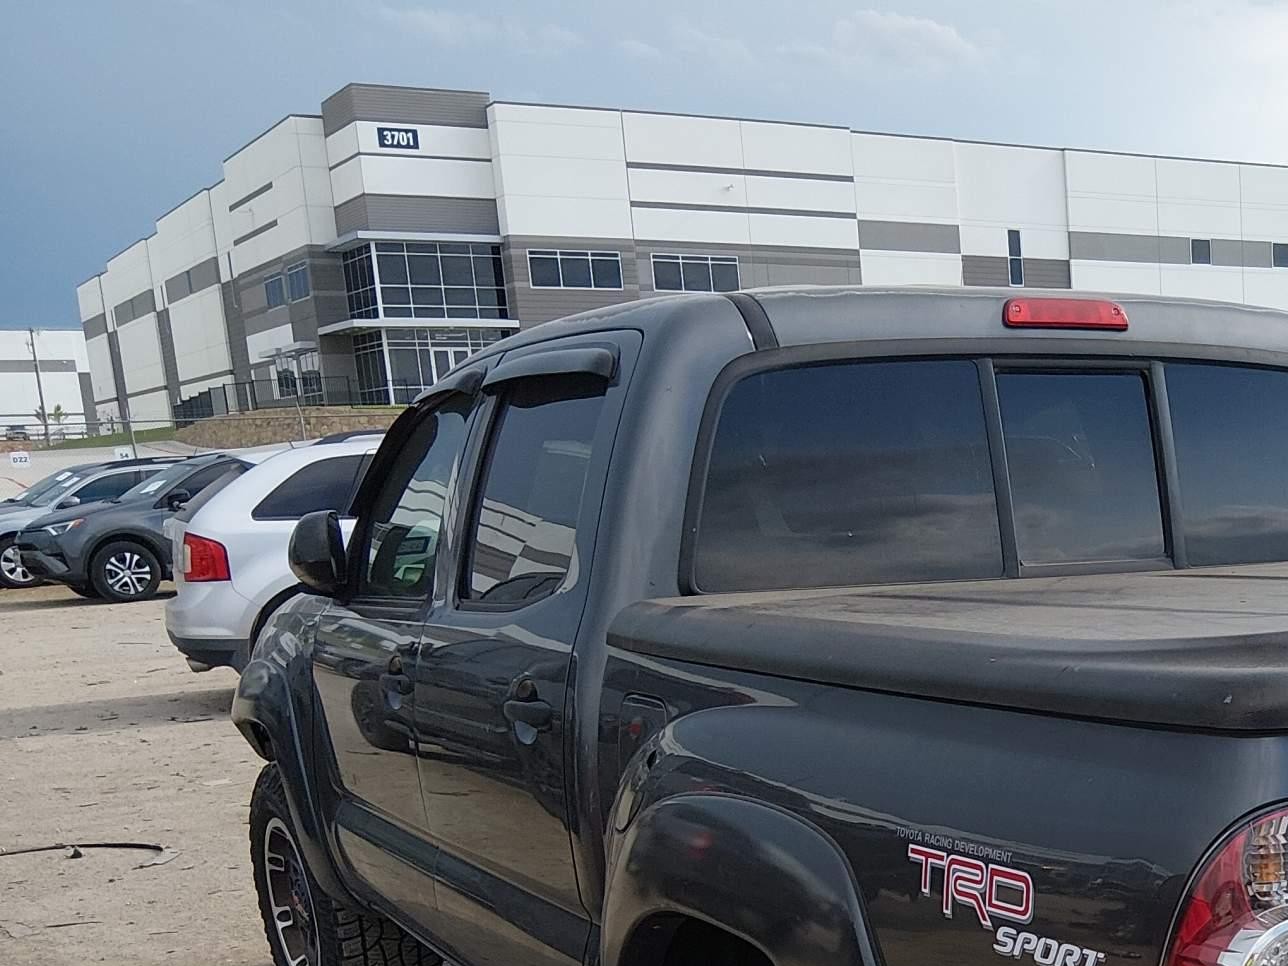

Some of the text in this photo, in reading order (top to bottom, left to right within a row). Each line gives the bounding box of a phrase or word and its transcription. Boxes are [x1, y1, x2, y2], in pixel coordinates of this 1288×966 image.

[383, 130, 414, 146] 3701
[896, 826, 1012, 864] TOYOTA RACING DEVELOPMENT
[908, 843, 1035, 931] TRD
